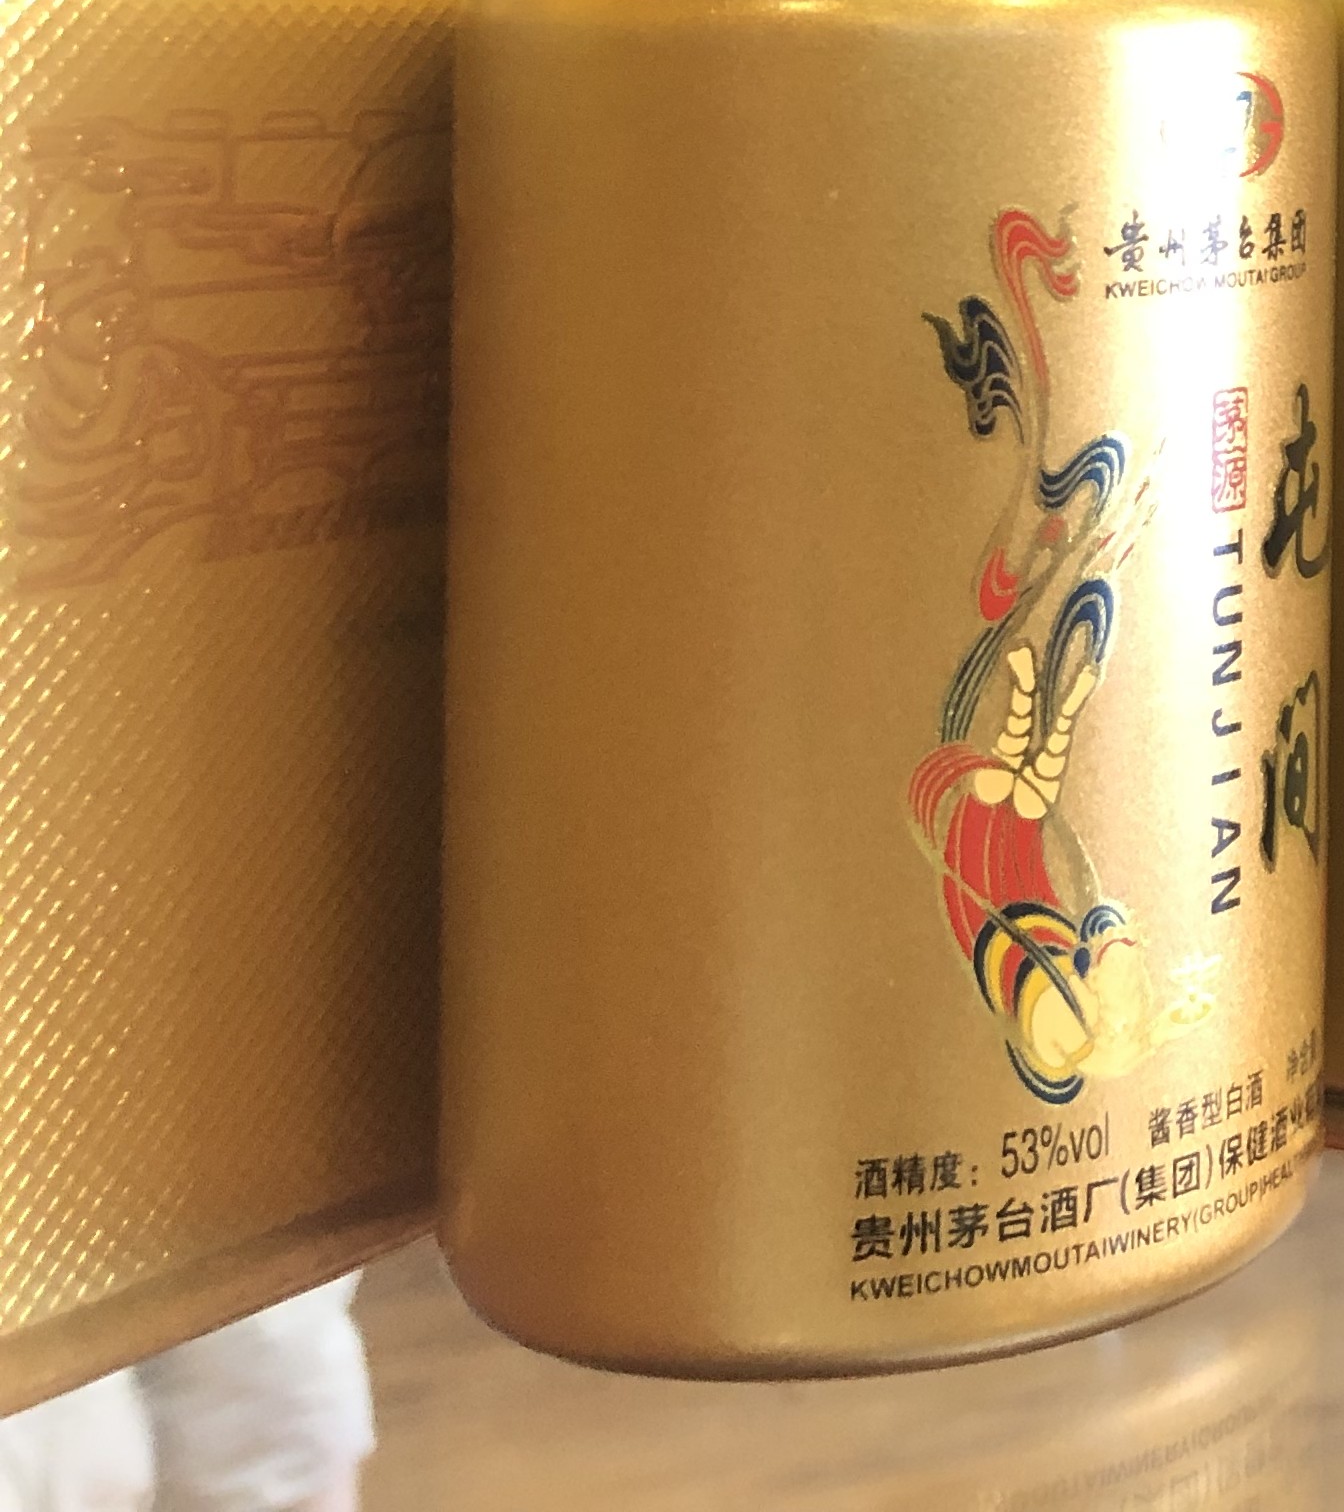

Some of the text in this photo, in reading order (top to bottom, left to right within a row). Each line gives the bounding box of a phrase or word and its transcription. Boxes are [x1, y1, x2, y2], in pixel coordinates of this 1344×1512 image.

[1211, 529, 1243, 916] TUNJIAN
[1000, 1110, 1110, 1180] 53%vol
[1149, 1068, 1265, 1147] 酱香型白酒
